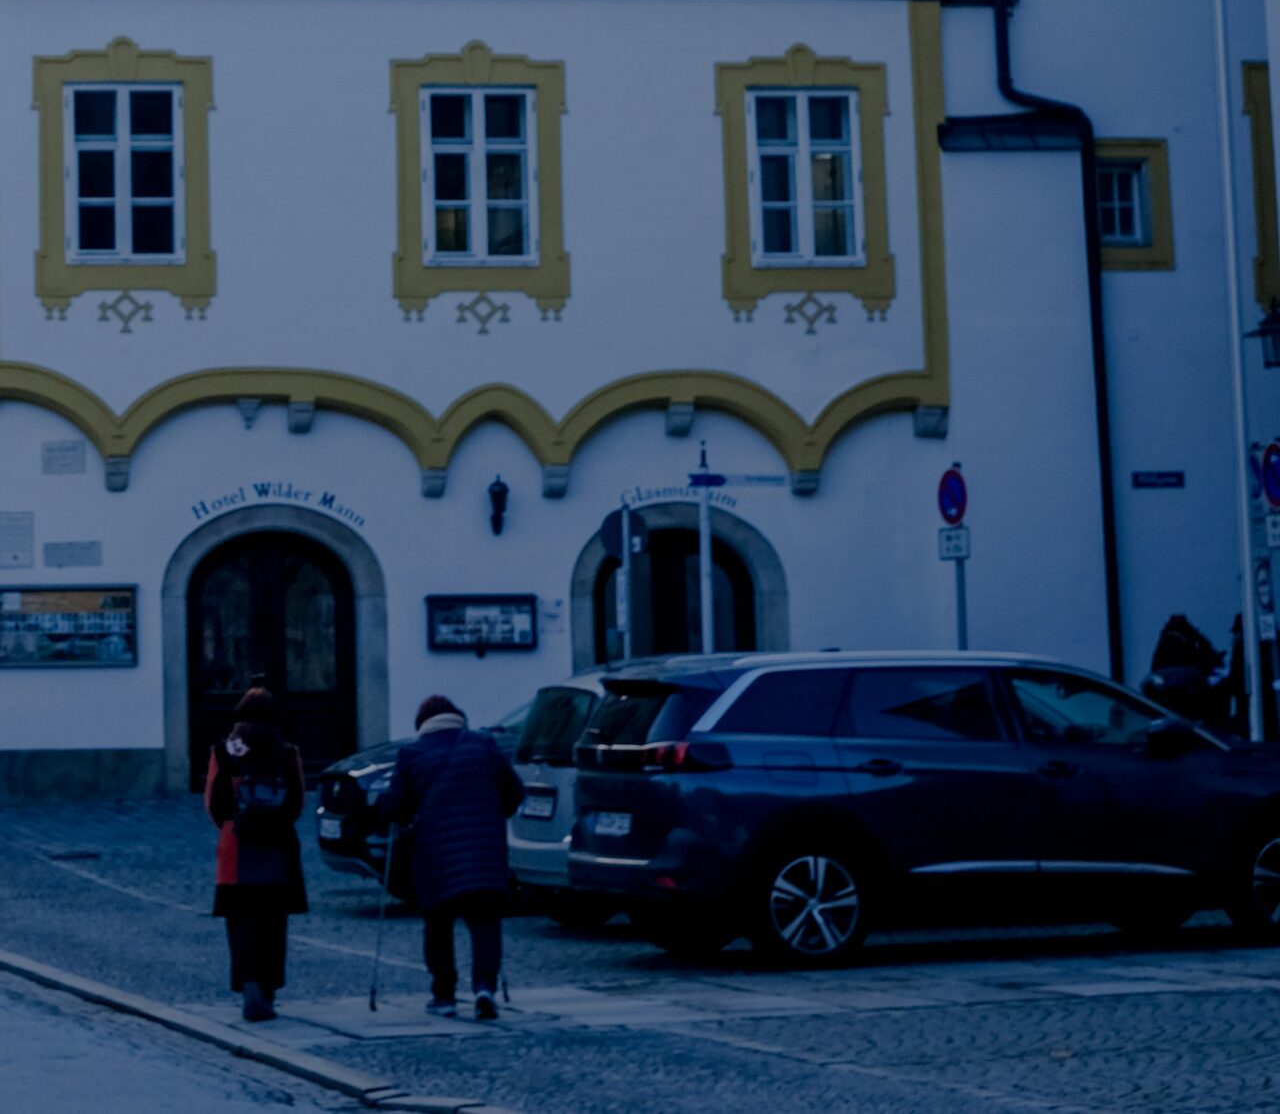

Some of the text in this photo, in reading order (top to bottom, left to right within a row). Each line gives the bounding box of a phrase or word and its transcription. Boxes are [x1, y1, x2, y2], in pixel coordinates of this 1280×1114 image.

[191, 482, 366, 528] Hotel Wilder Mann
[621, 486, 737, 507] Glasmusum
